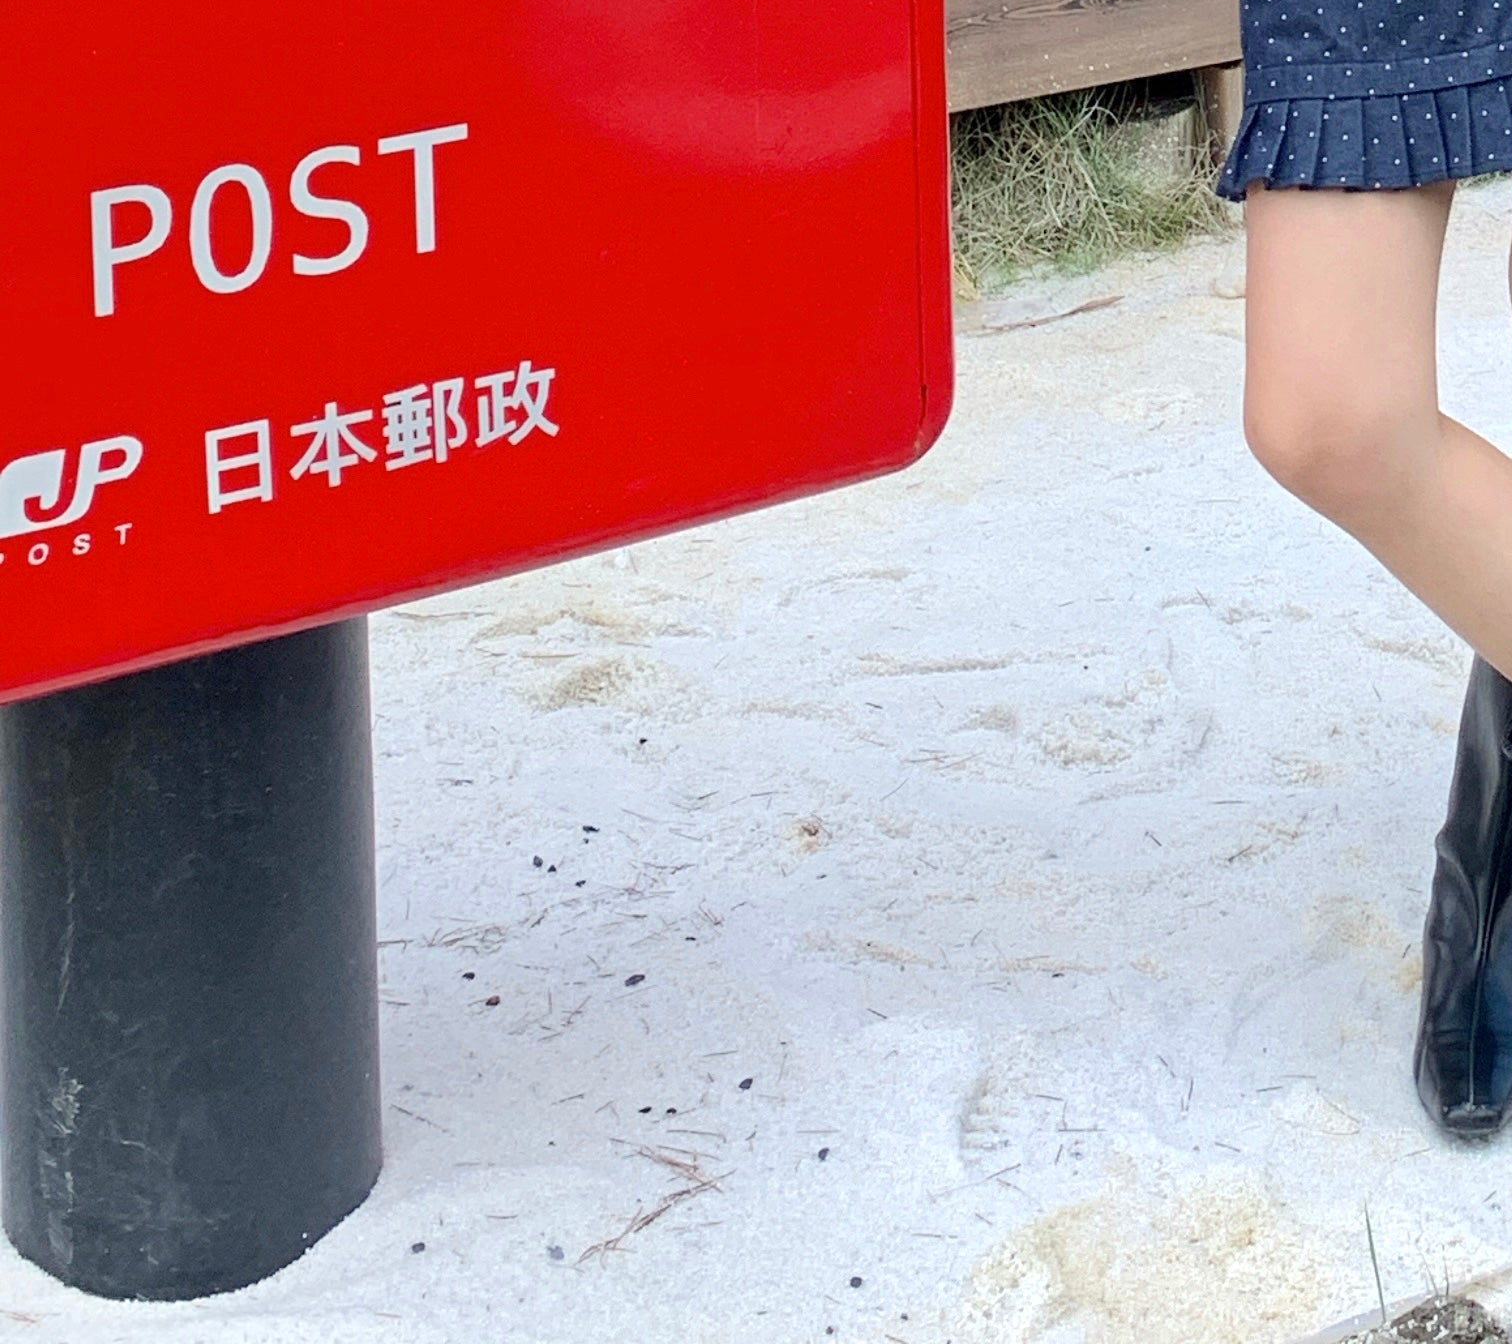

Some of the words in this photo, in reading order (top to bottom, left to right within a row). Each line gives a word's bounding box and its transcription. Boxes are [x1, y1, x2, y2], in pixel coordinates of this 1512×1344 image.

[90, 122, 469, 318] POST
[204, 359, 560, 515] 日本郵政
[0, 522, 133, 566] OST
